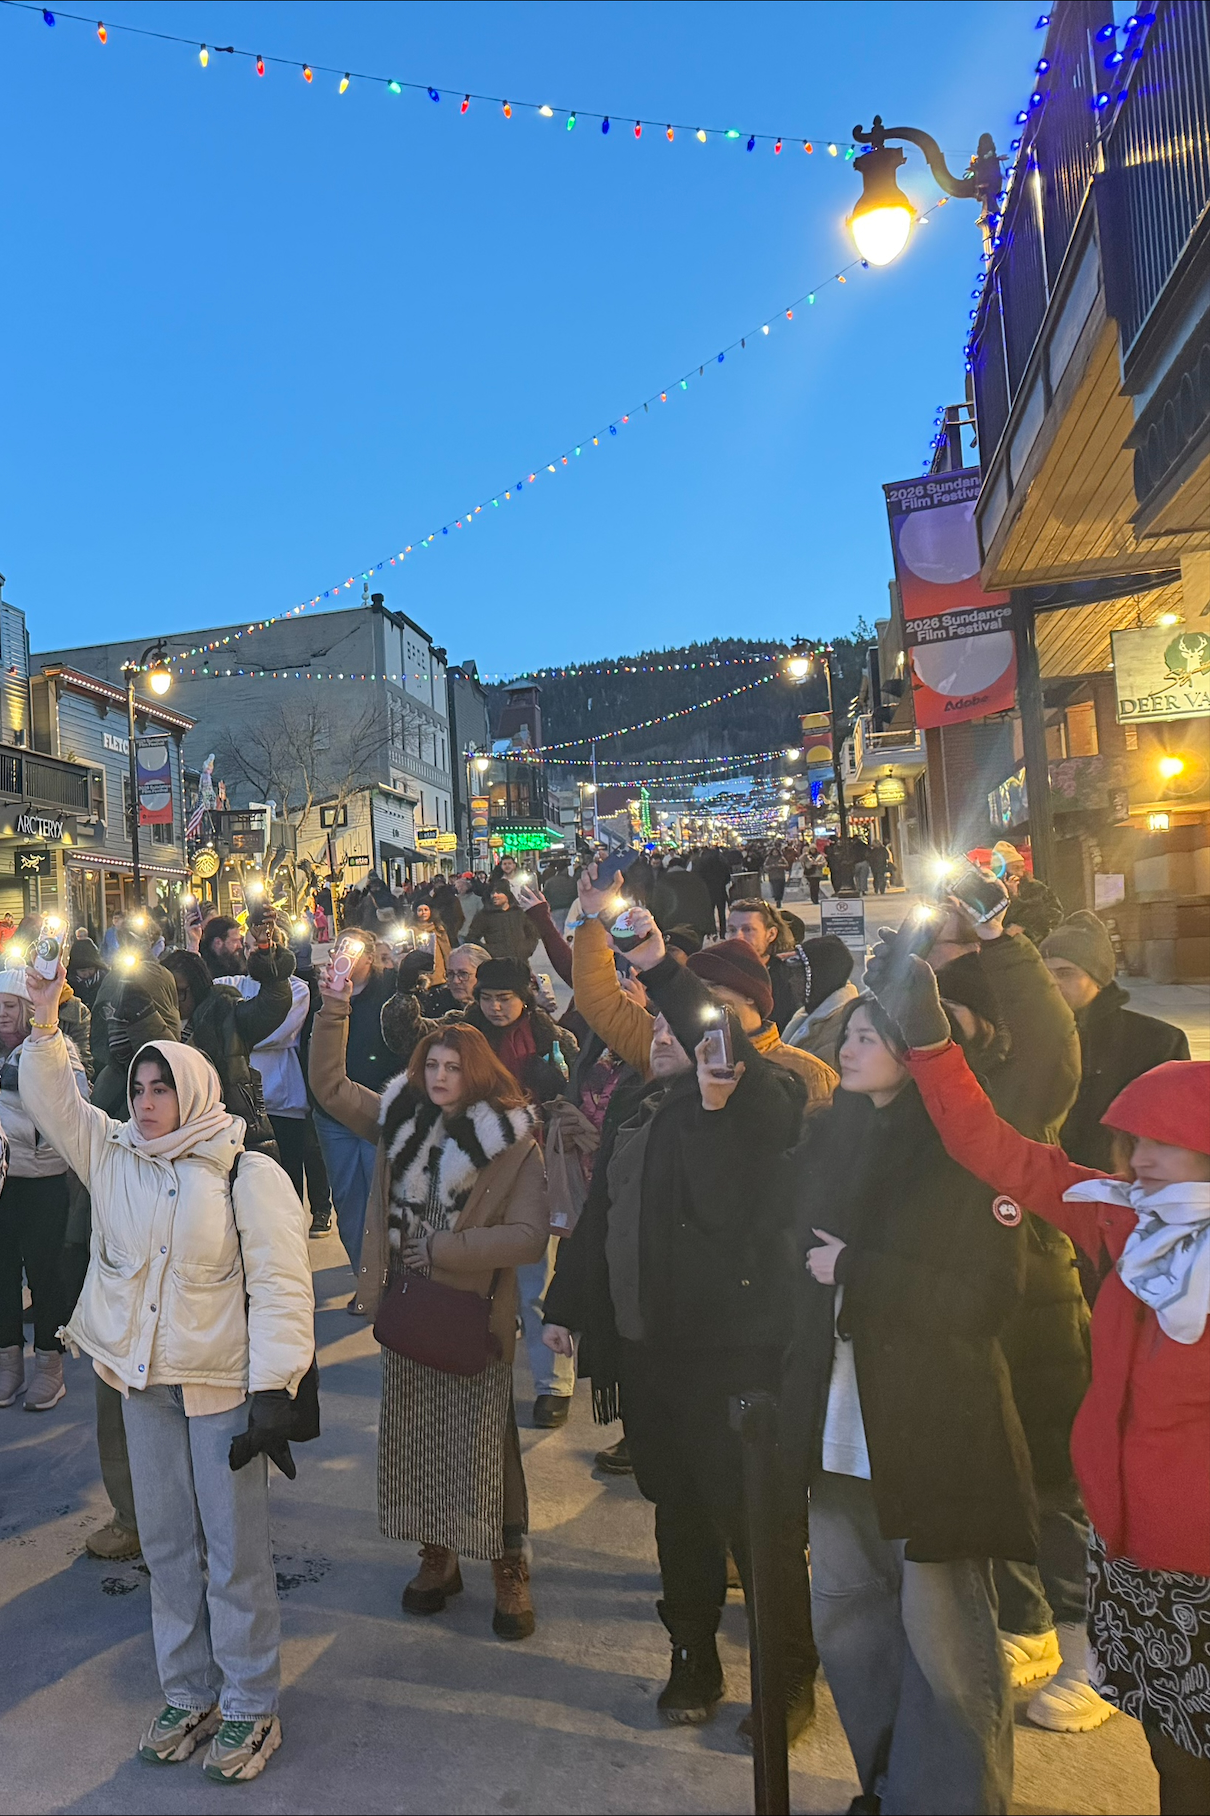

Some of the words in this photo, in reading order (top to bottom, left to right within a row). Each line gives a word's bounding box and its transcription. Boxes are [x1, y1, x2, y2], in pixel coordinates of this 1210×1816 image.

[890, 487, 924, 501] 2026
[927, 477, 981, 494] Sundan
[901, 496, 930, 510] Film
[933, 487, 981, 504] Festiva
[906, 617, 939, 633] 2026
[942, 607, 1012, 626] Sundance
[917, 629, 946, 642] Film
[948, 618, 1002, 637] Festival
[944, 696, 989, 712] Adobe
[1120, 695, 1181, 715] DEER
[103, 733, 129, 755] FLETC
